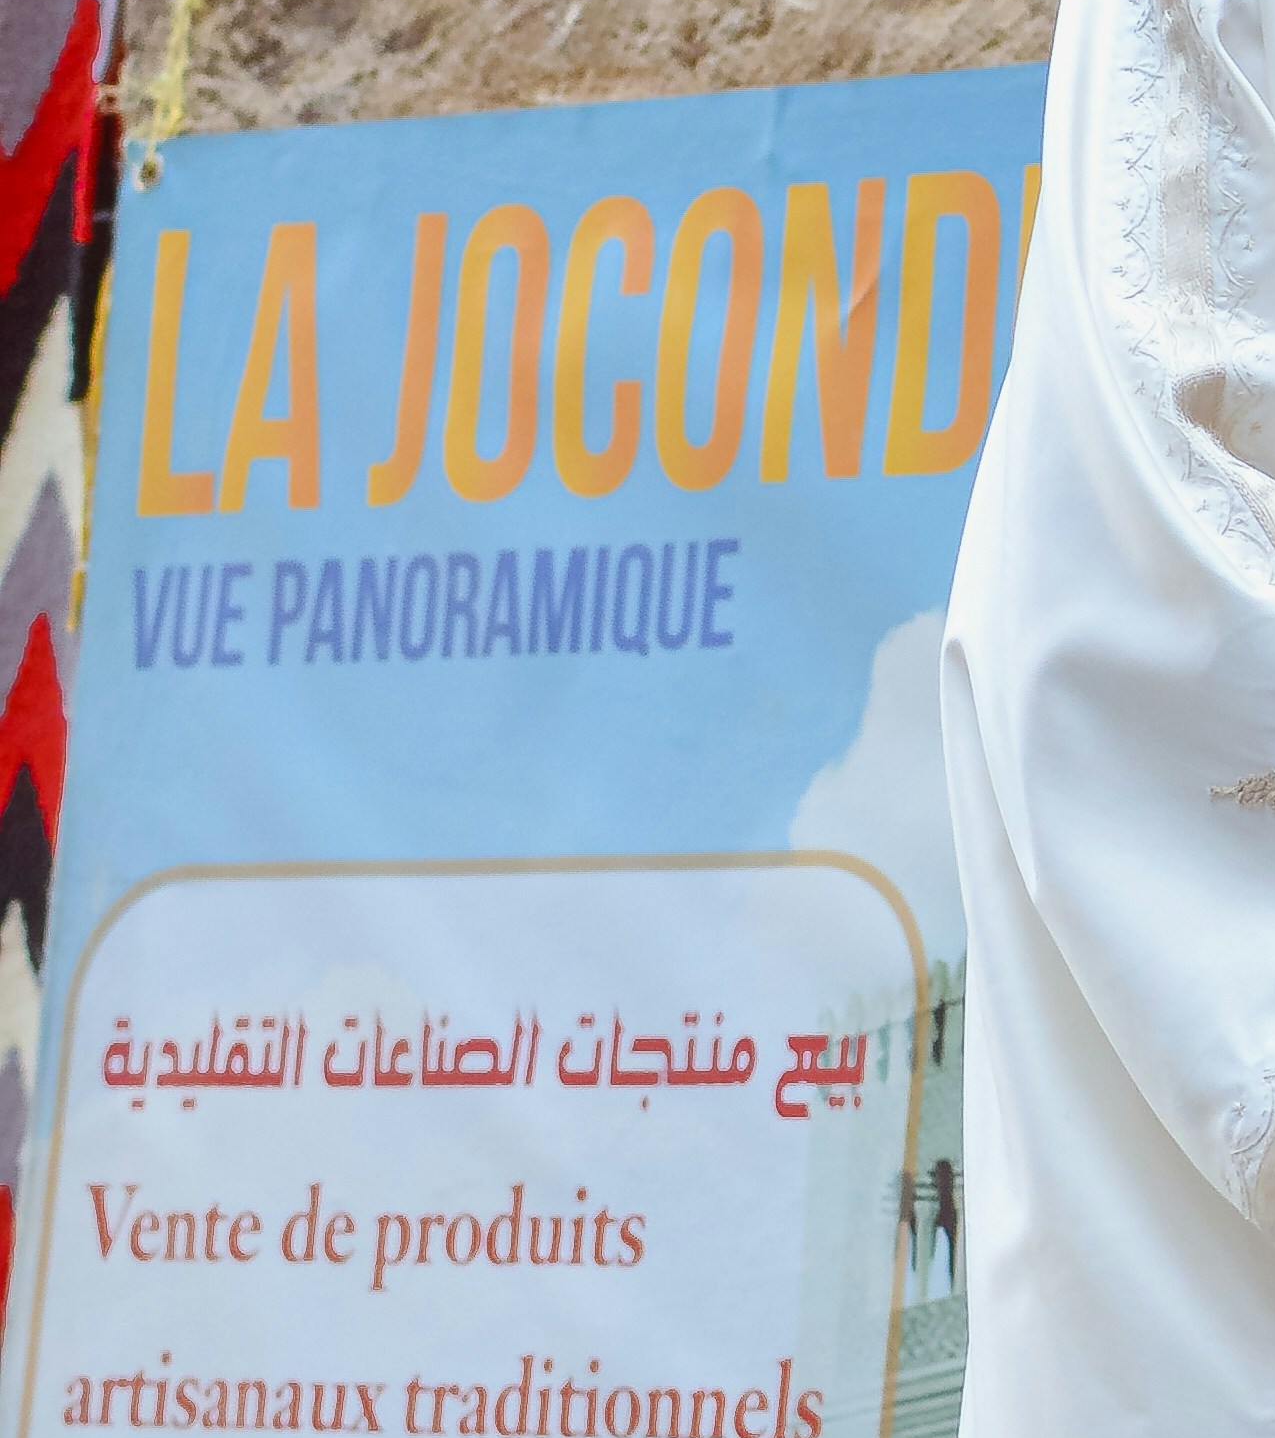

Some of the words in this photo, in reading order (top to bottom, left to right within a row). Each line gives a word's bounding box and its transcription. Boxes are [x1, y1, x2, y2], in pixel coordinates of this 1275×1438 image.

[136, 221, 320, 518] LA
[367, 164, 1041, 508] JOCOND
[131, 562, 253, 671] VUE
[268, 537, 741, 665] PANORAMIQUE
[102, 1012, 307, 1110] التقليدية
[323, 1007, 541, 1087] الصناعات
[558, 1009, 756, 1110] منتجات
[776, 1032, 868, 1119] بيع
[88, 1183, 260, 1262] Vente
[280, 1183, 354, 1262] de
[370, 1184, 647, 1292] produits
[62, 1352, 385, 1434] artisanaux
